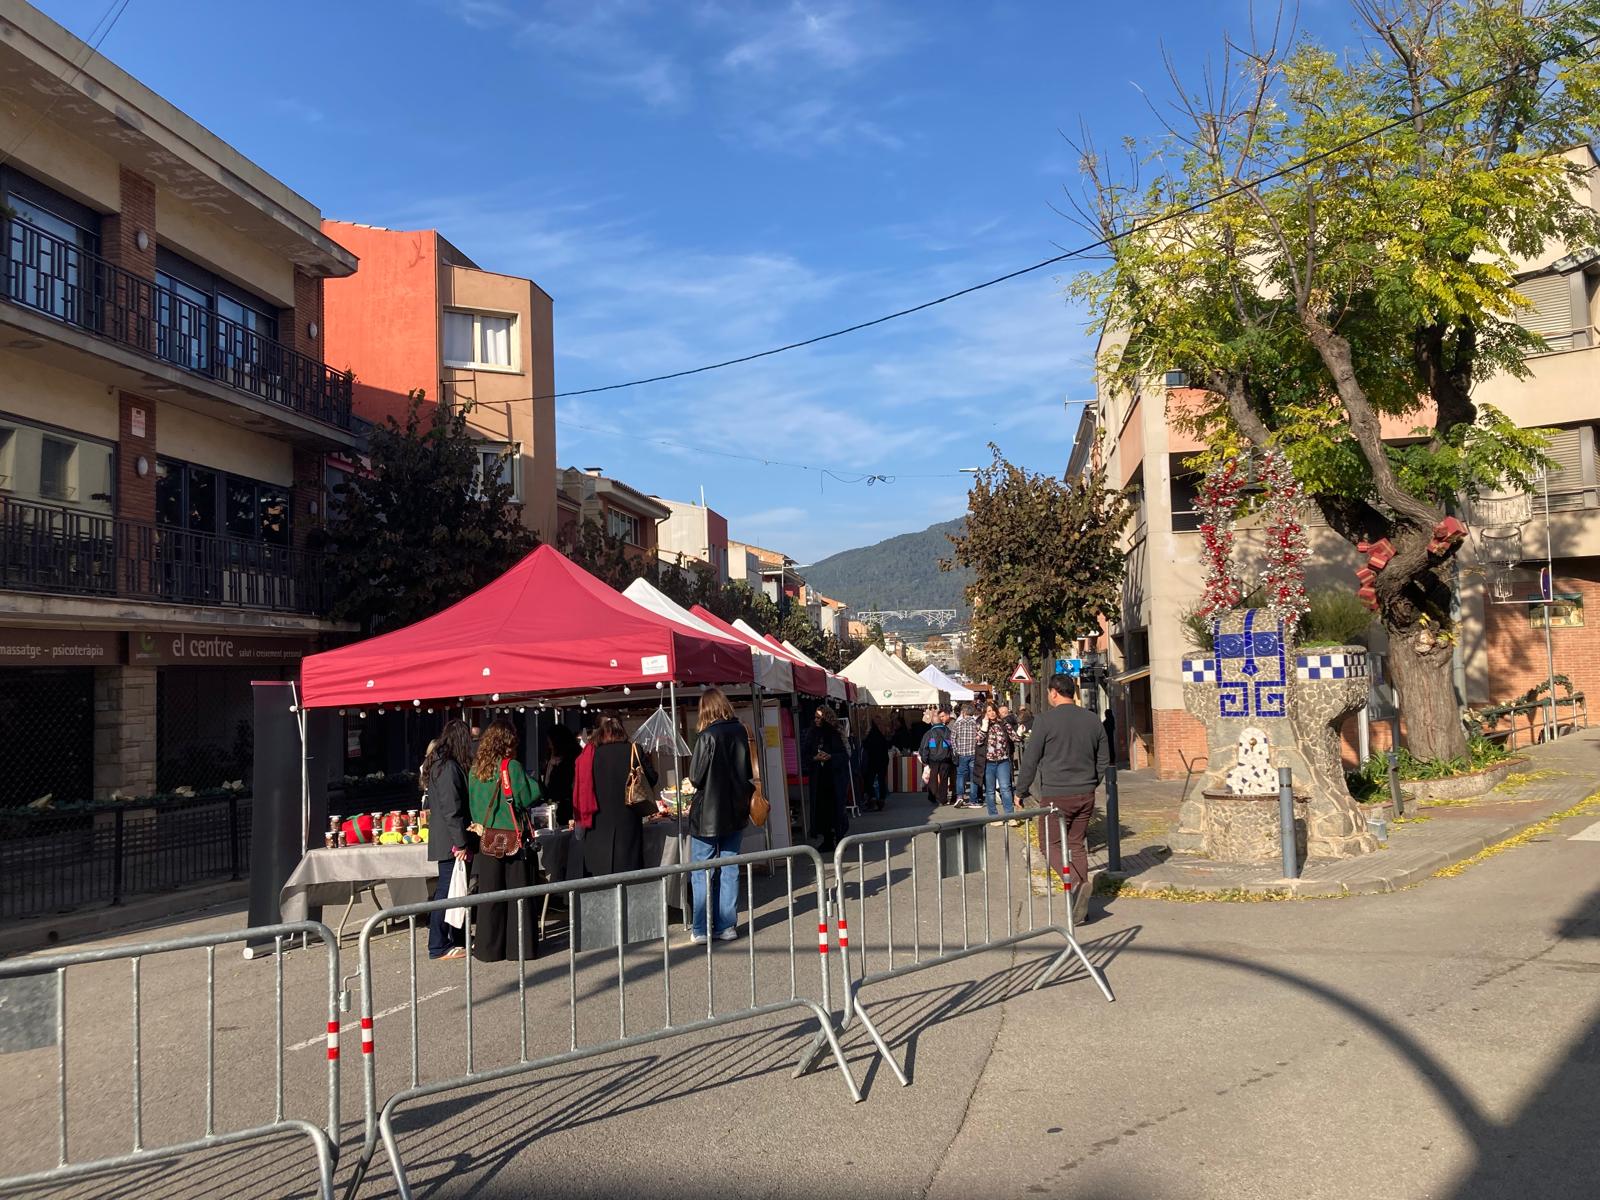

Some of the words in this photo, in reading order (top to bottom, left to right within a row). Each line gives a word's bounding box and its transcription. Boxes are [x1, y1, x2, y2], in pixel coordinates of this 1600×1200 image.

[0, 644, 42, 659] massatge
[52, 643, 104, 659] psicoteràpia
[172, 632, 185, 657] el
[190, 636, 234, 658] centre
